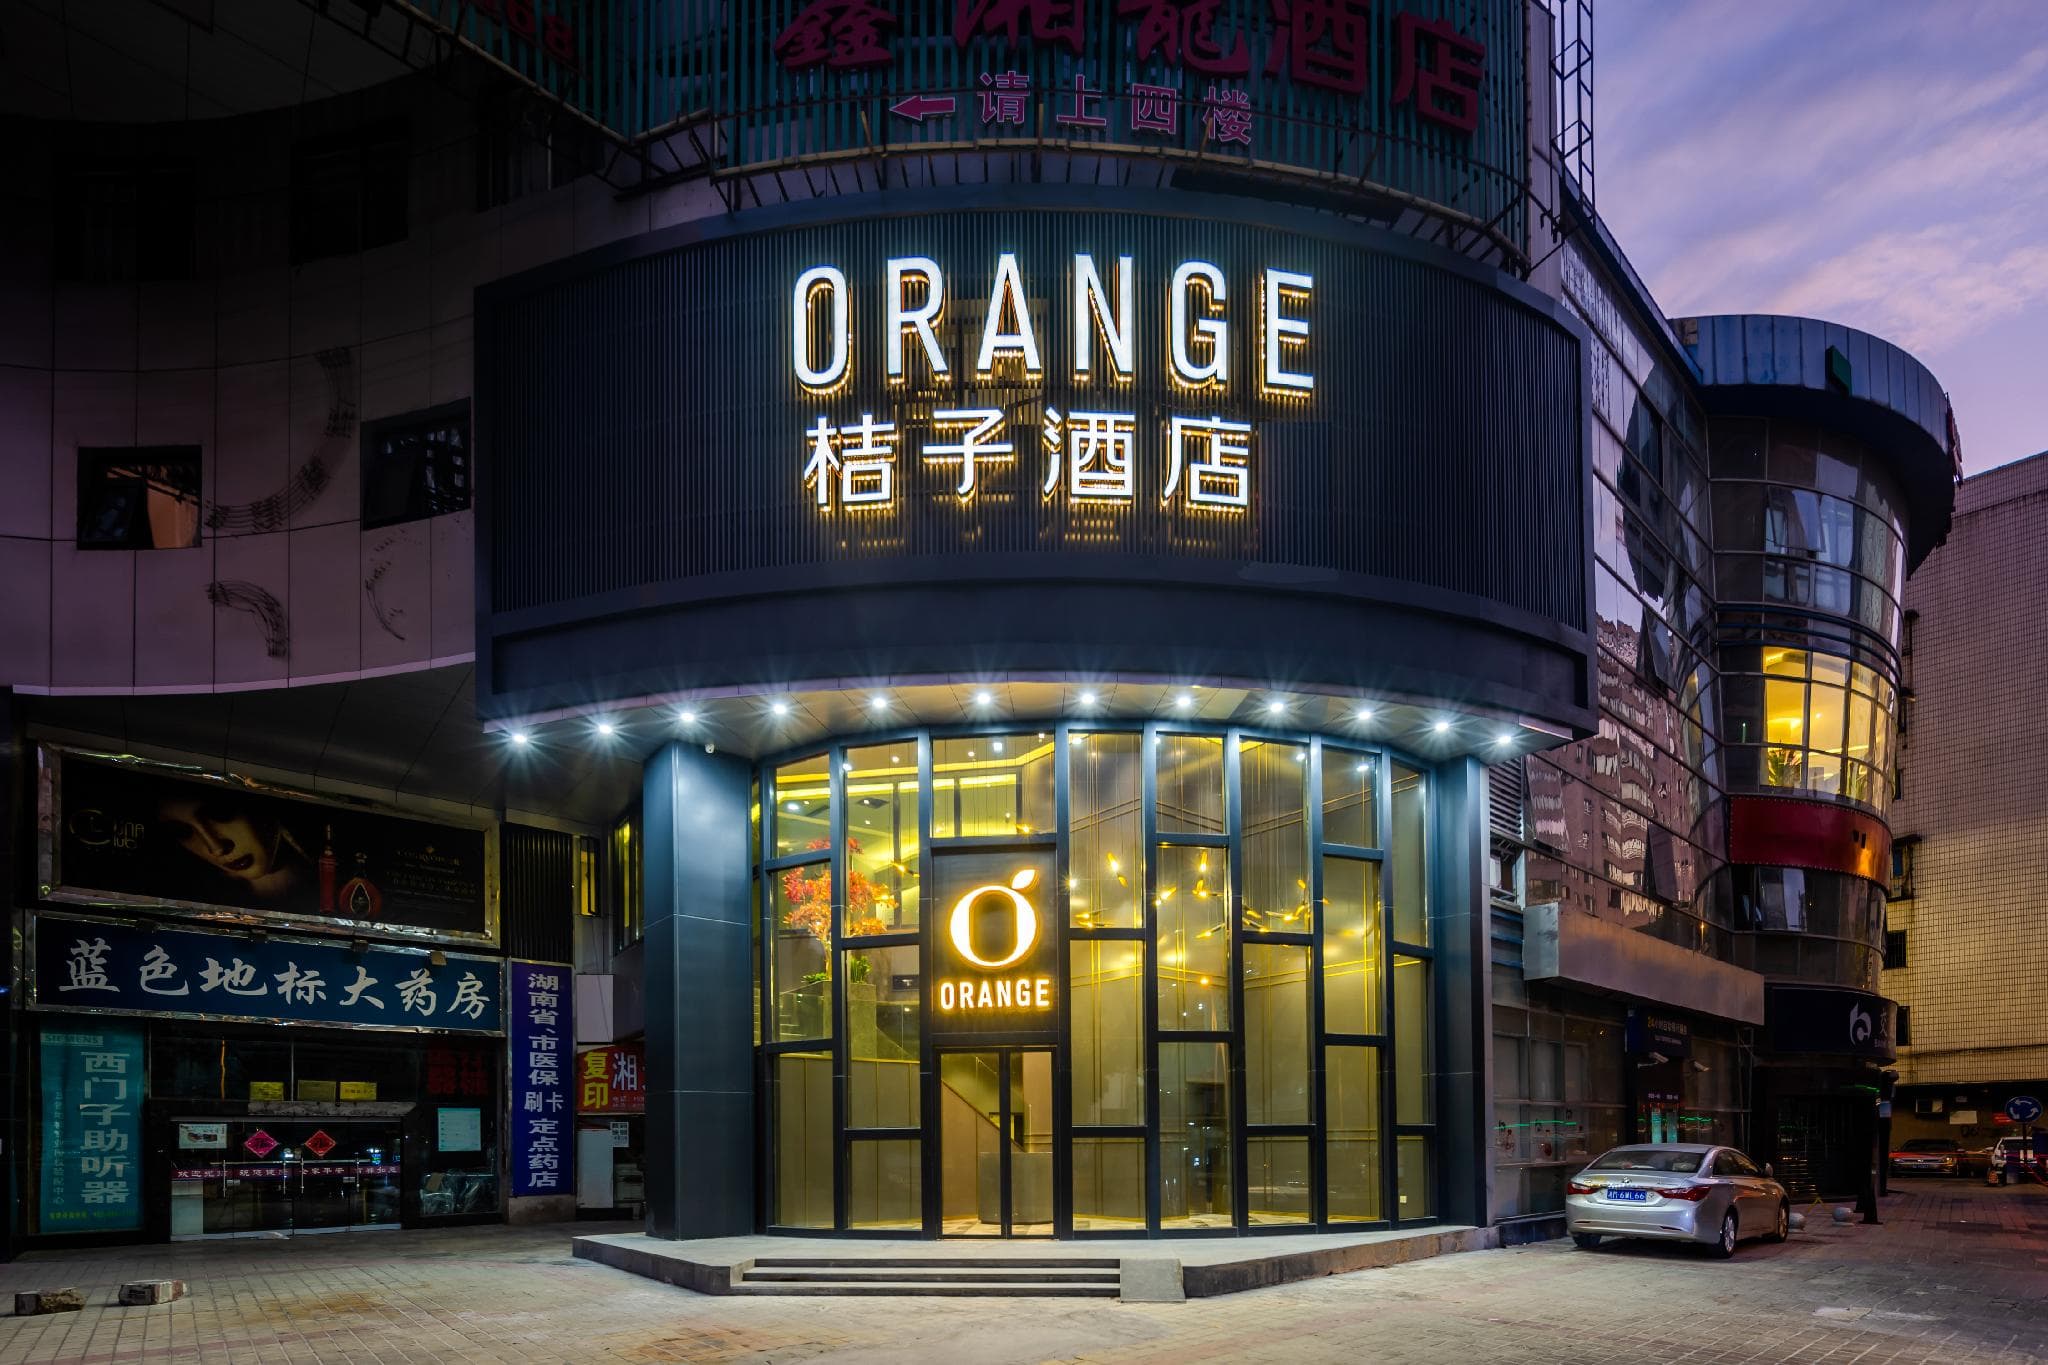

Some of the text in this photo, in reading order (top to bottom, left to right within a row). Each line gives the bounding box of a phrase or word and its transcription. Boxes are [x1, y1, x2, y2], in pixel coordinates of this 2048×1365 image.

[977, 72, 1252, 145] 请上四楼
[793, 253, 1314, 390] ORANGE
[804, 408, 1252, 507] 桔子酒店
[58, 938, 492, 1020] 蓝色地标大药房
[939, 978, 1050, 1010] ORANGE
[583, 1051, 609, 1109] 复印
[612, 1052, 646, 1091] 湘
[80, 1051, 131, 1204] 西门子助听器
